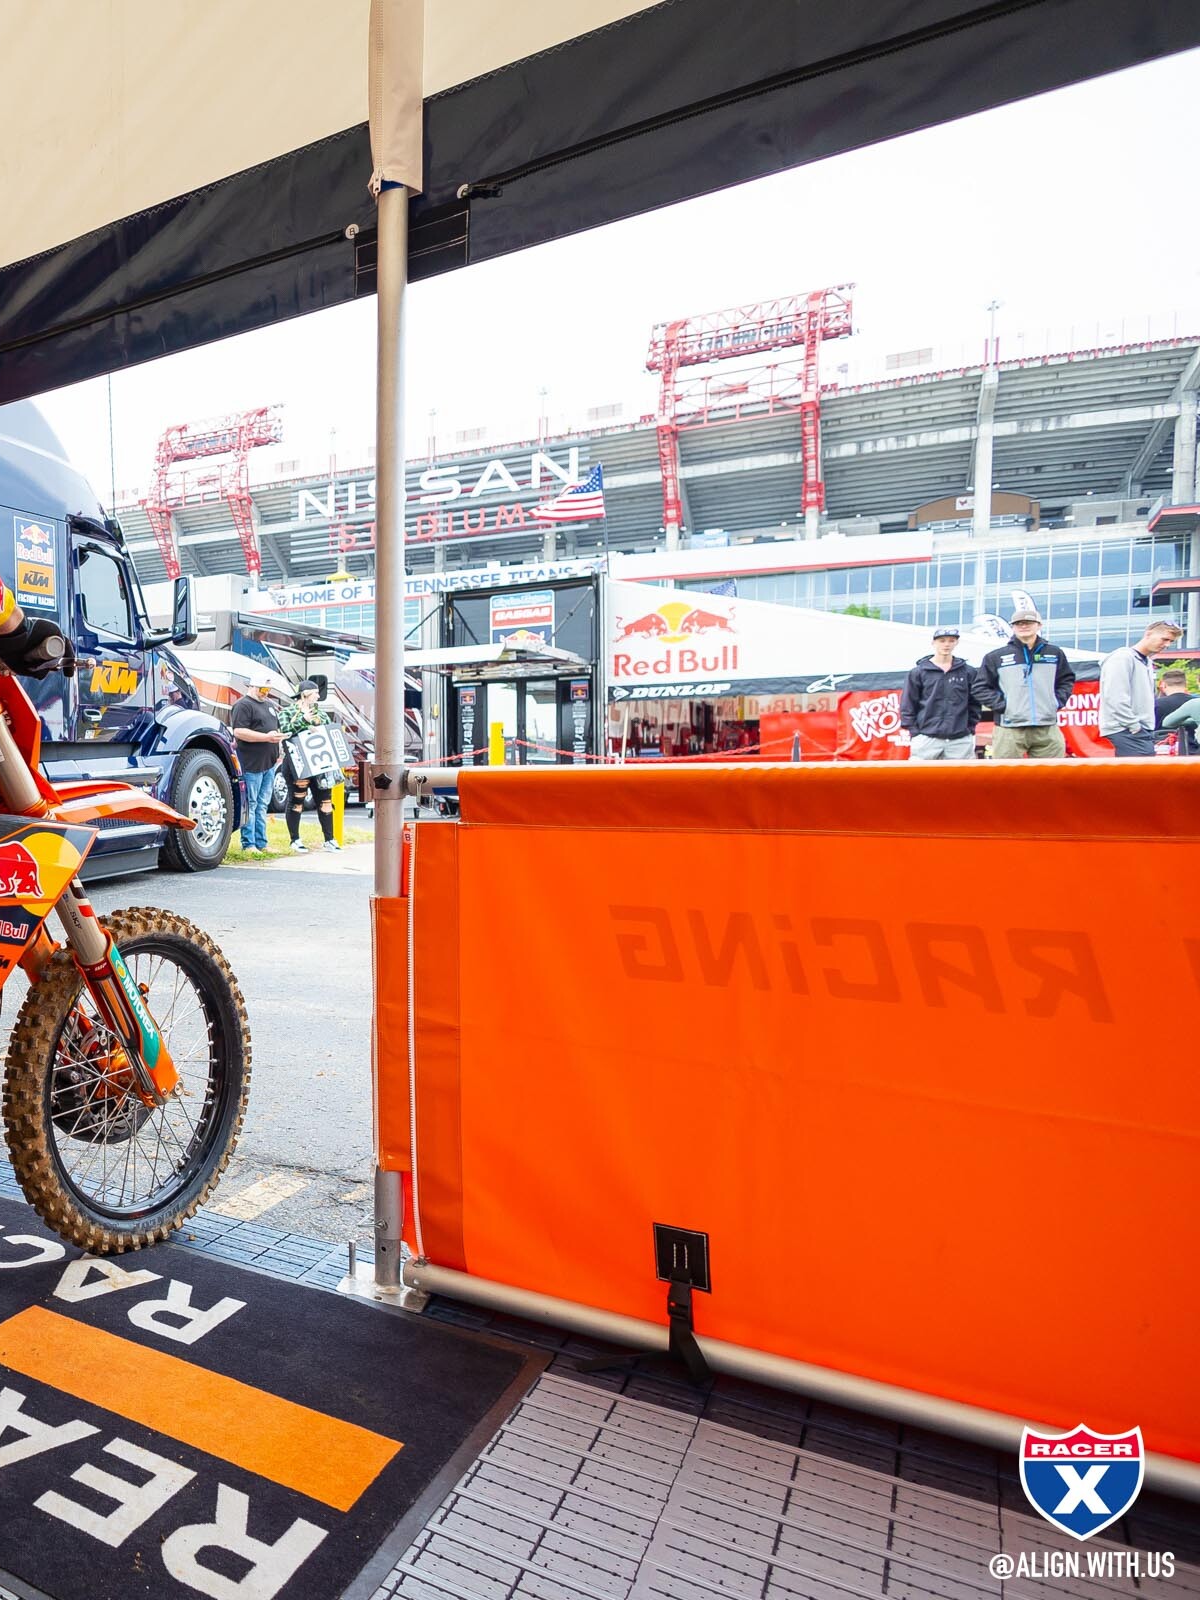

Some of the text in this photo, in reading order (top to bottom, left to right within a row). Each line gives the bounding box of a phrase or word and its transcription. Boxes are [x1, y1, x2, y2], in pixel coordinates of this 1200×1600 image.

[299, 447, 579, 521] NISAN
[339, 502, 526, 552] STDIUM
[23, 570, 49, 588] KTM
[292, 588, 336, 605] HOME
[341, 585, 363, 602] OF
[404, 573, 501, 595] TENNESSEE
[508, 567, 573, 580] TITANS
[90, 660, 138, 695] KTM
[613, 645, 738, 677] Red Bull
[629, 683, 731, 699] DUNLOP
[0, 921, 29, 940] Bull
[122, 977, 156, 1040] MOTOREX
